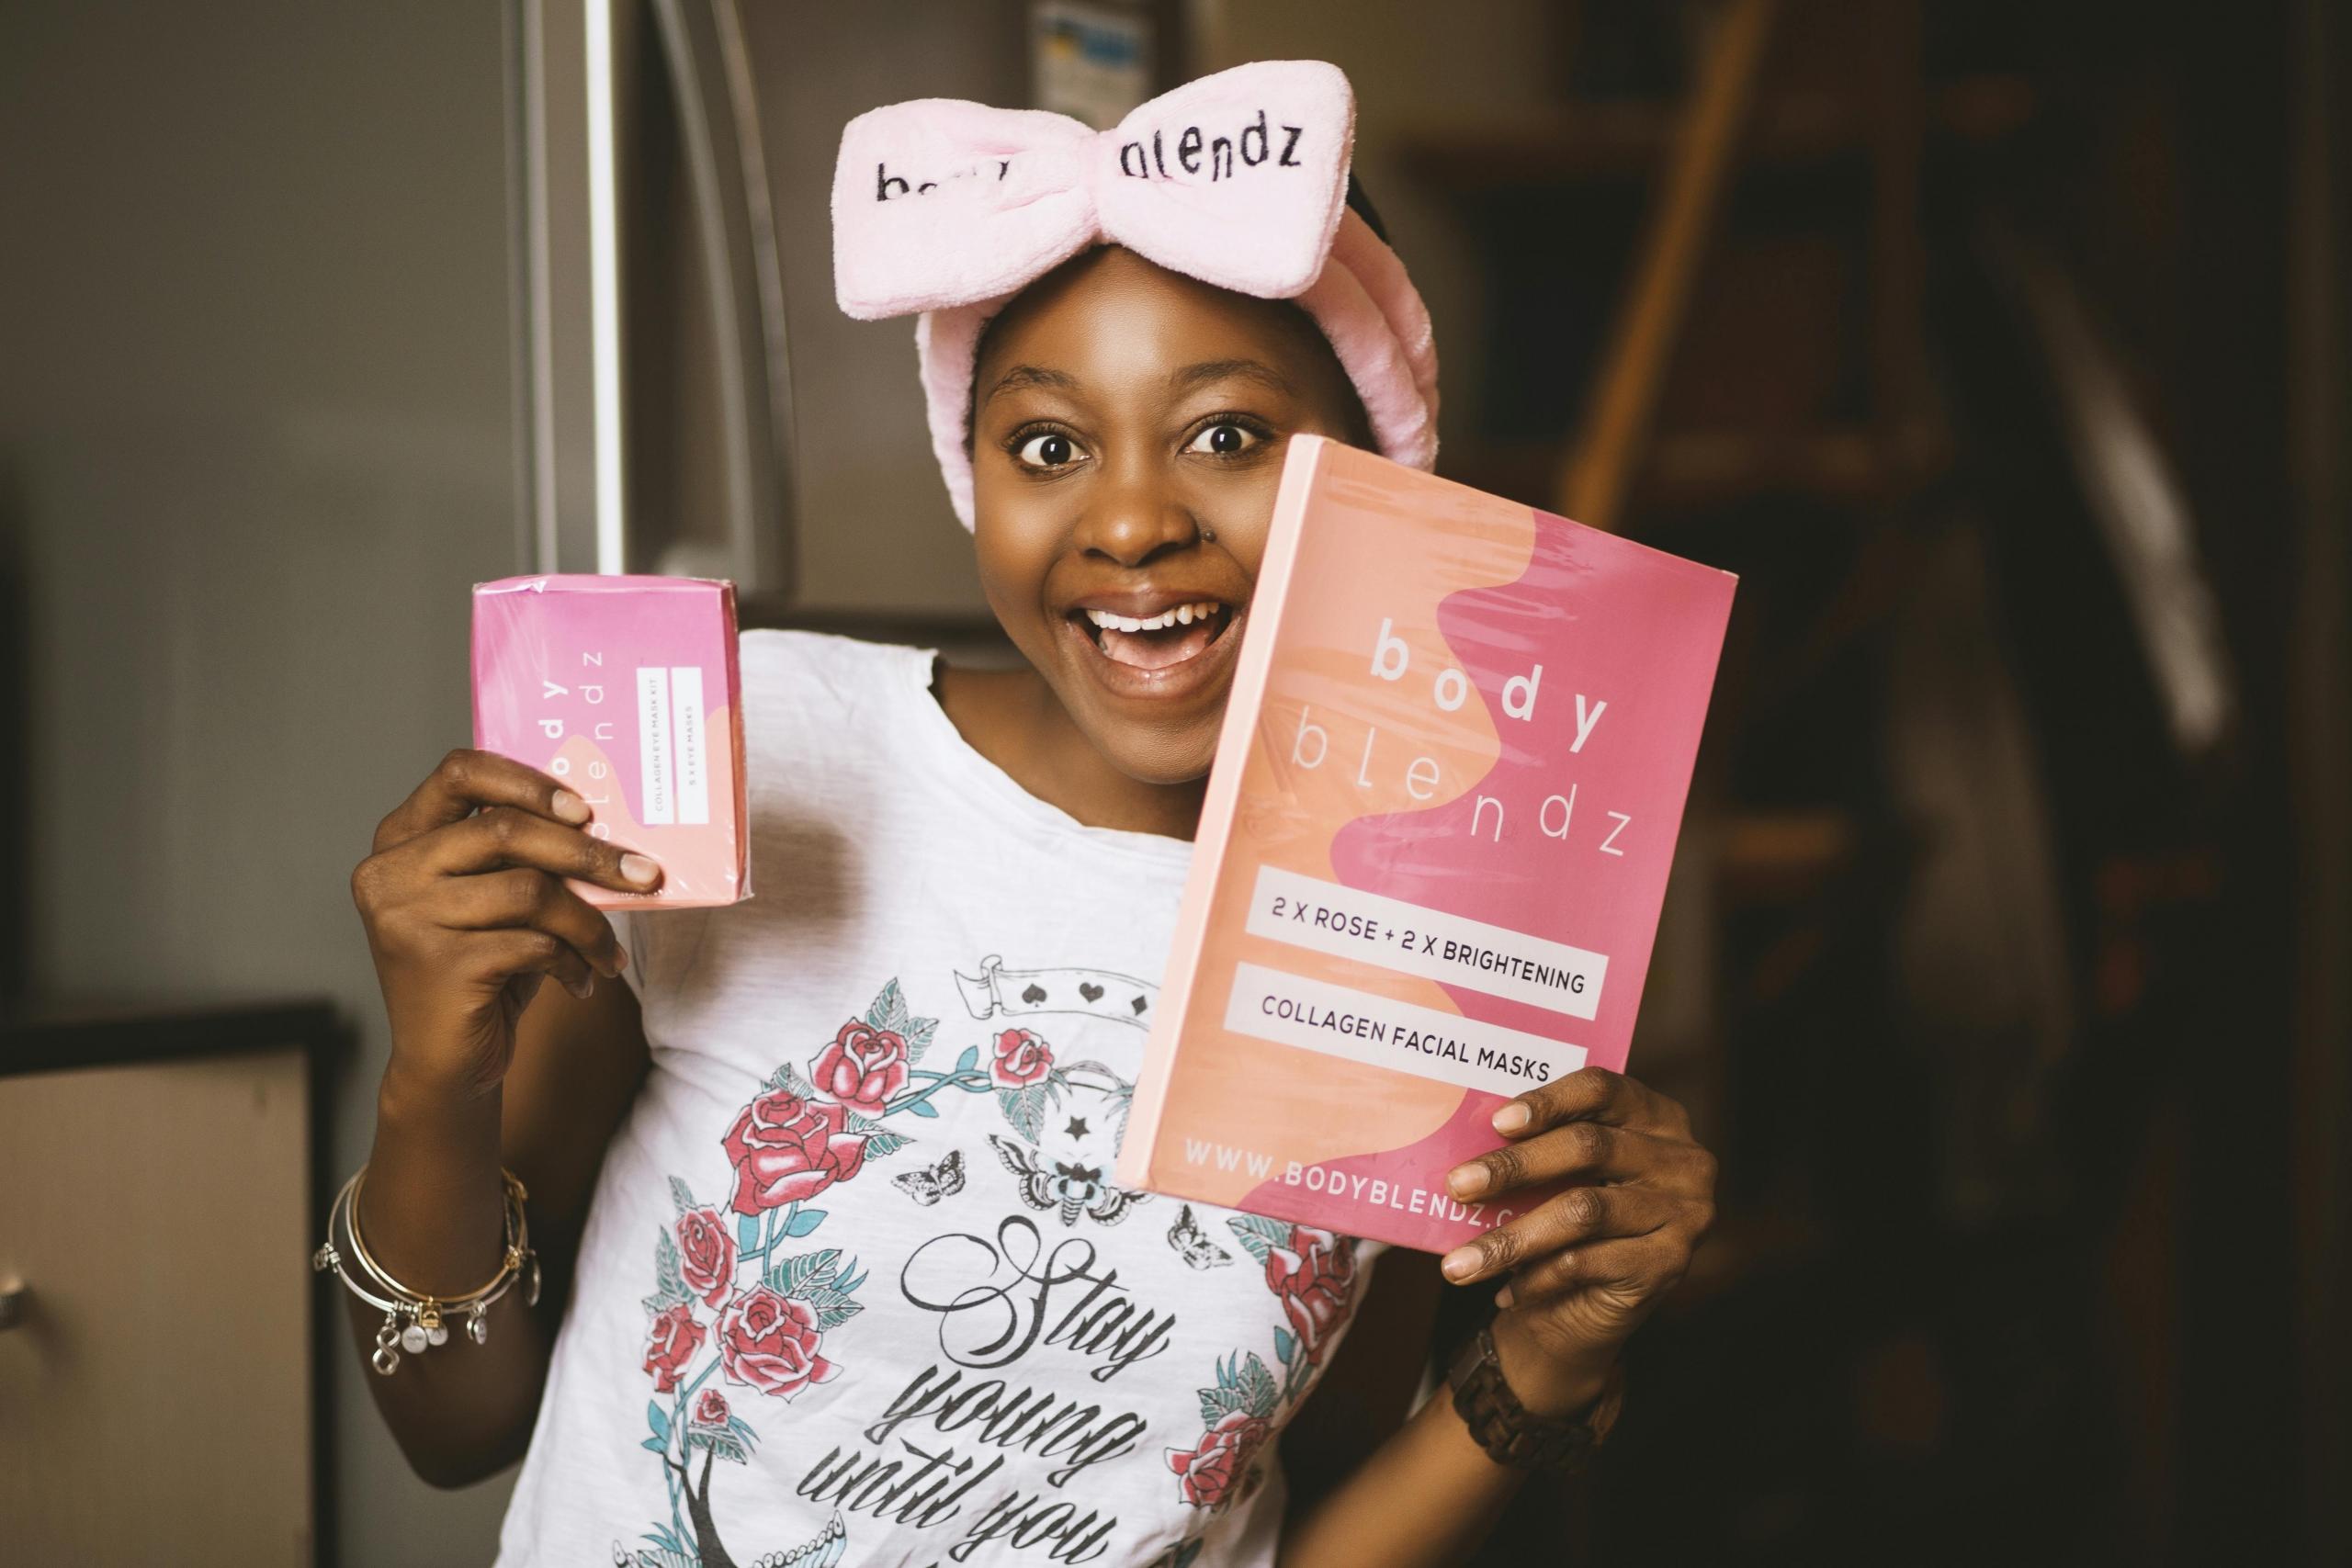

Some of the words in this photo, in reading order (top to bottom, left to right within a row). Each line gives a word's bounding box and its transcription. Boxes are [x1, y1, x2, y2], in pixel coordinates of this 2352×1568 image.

[537, 680, 570, 776] ody
[649, 678, 657, 695] KIT
[650, 699, 659, 728] MASK
[685, 705, 695, 743] MASKS
[1370, 617, 1608, 753] body
[652, 732, 661, 751] EYE
[653, 754, 663, 812] COLLAGEN
[687, 747, 695, 766] EYE
[1292, 705, 1632, 856] blendz
[1272, 897, 1287, 917] 2
[1293, 901, 1308, 923] X
[1314, 907, 1378, 942] ROSE
[1385, 929, 1396, 942] +
[1401, 930, 1417, 951] 2
[1422, 934, 1438, 956] X
[1443, 940, 1586, 994] BRIGHTENING
[1261, 995, 1386, 1043] COLLAGEN
[1392, 1027, 1470, 1064] FACIAL
[1477, 1047, 1551, 1082] MASKS
[1186, 1138, 1525, 1229] WWW.BODYBLENDZ.C
[900, 1213, 1177, 1382] Stay
[864, 1364, 1148, 1489] young
[797, 1437, 1005, 1529] until
[948, 1489, 1118, 1565] you
